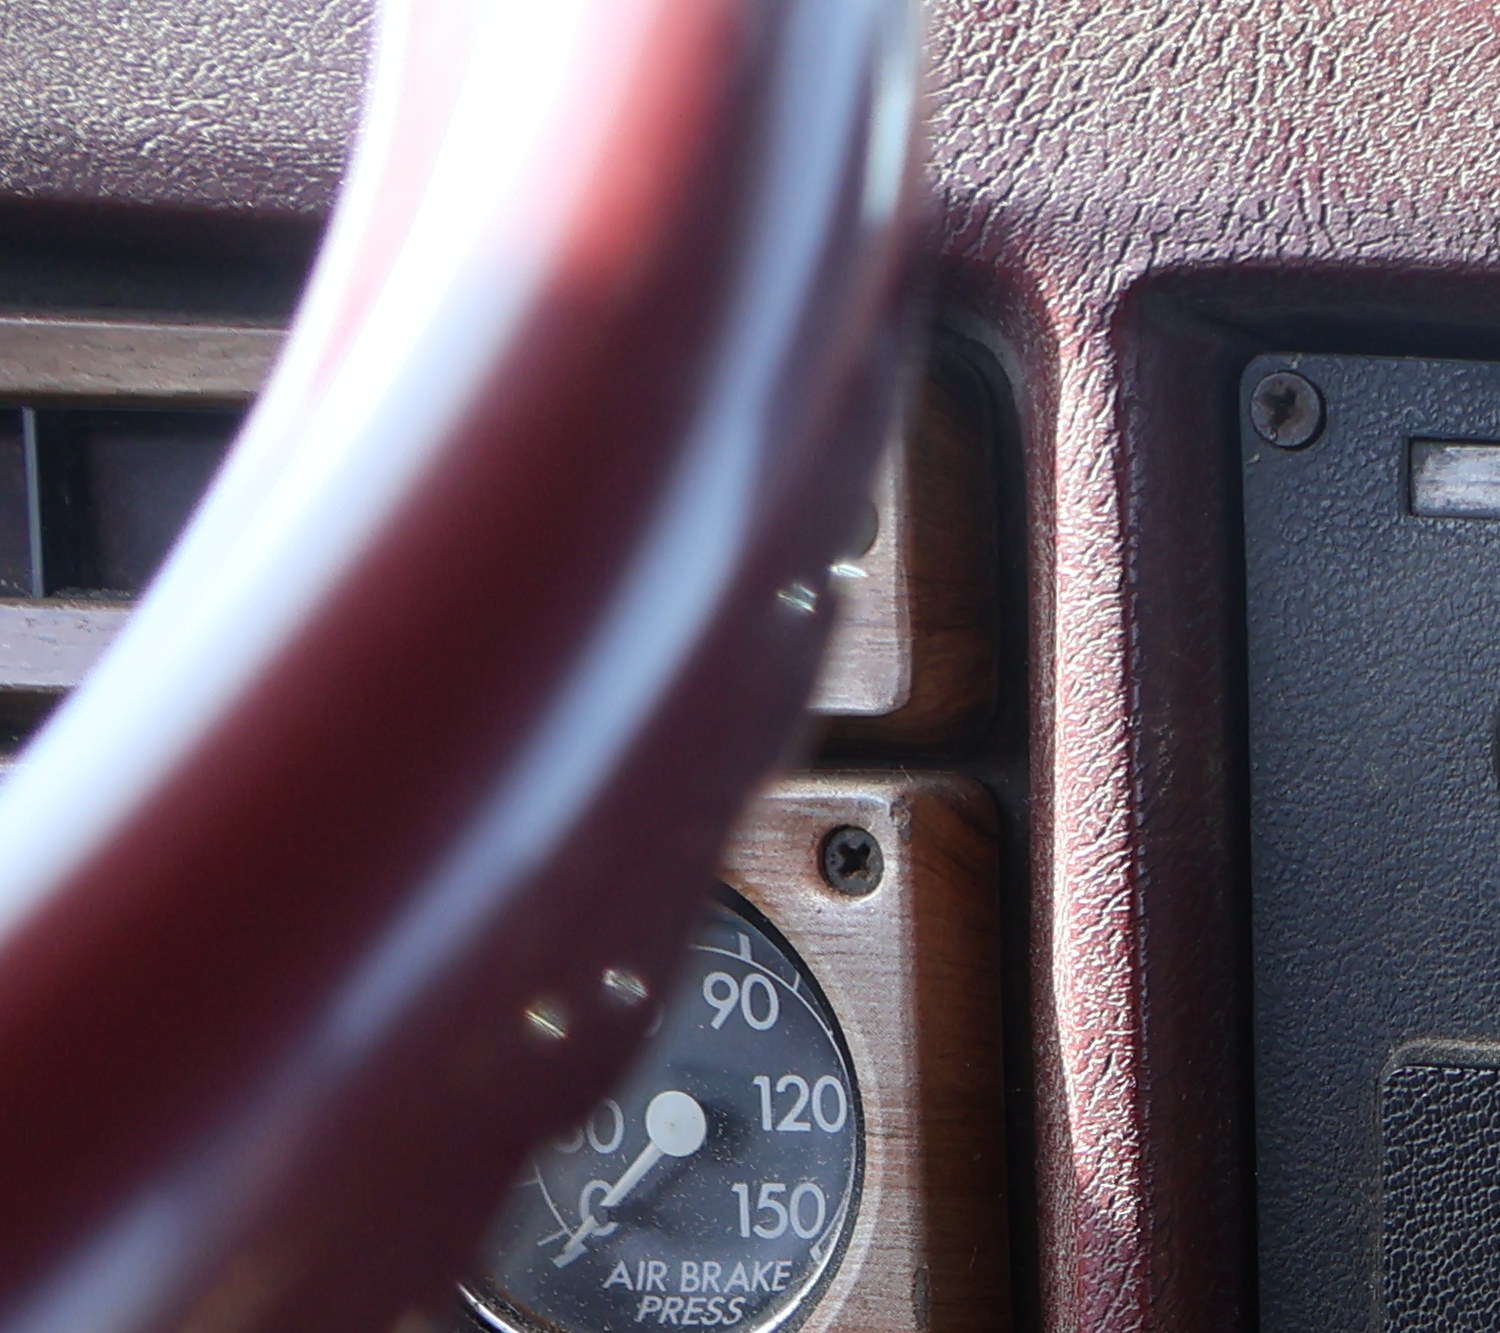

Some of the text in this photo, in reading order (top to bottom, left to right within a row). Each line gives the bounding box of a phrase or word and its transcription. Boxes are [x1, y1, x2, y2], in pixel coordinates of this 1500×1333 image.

[702, 971, 780, 1031] 90
[753, 1074, 848, 1133] 120
[731, 1182, 827, 1239] 150
[602, 1259, 793, 1294] AIR BRAKE
[634, 1296, 747, 1326] PRESS
